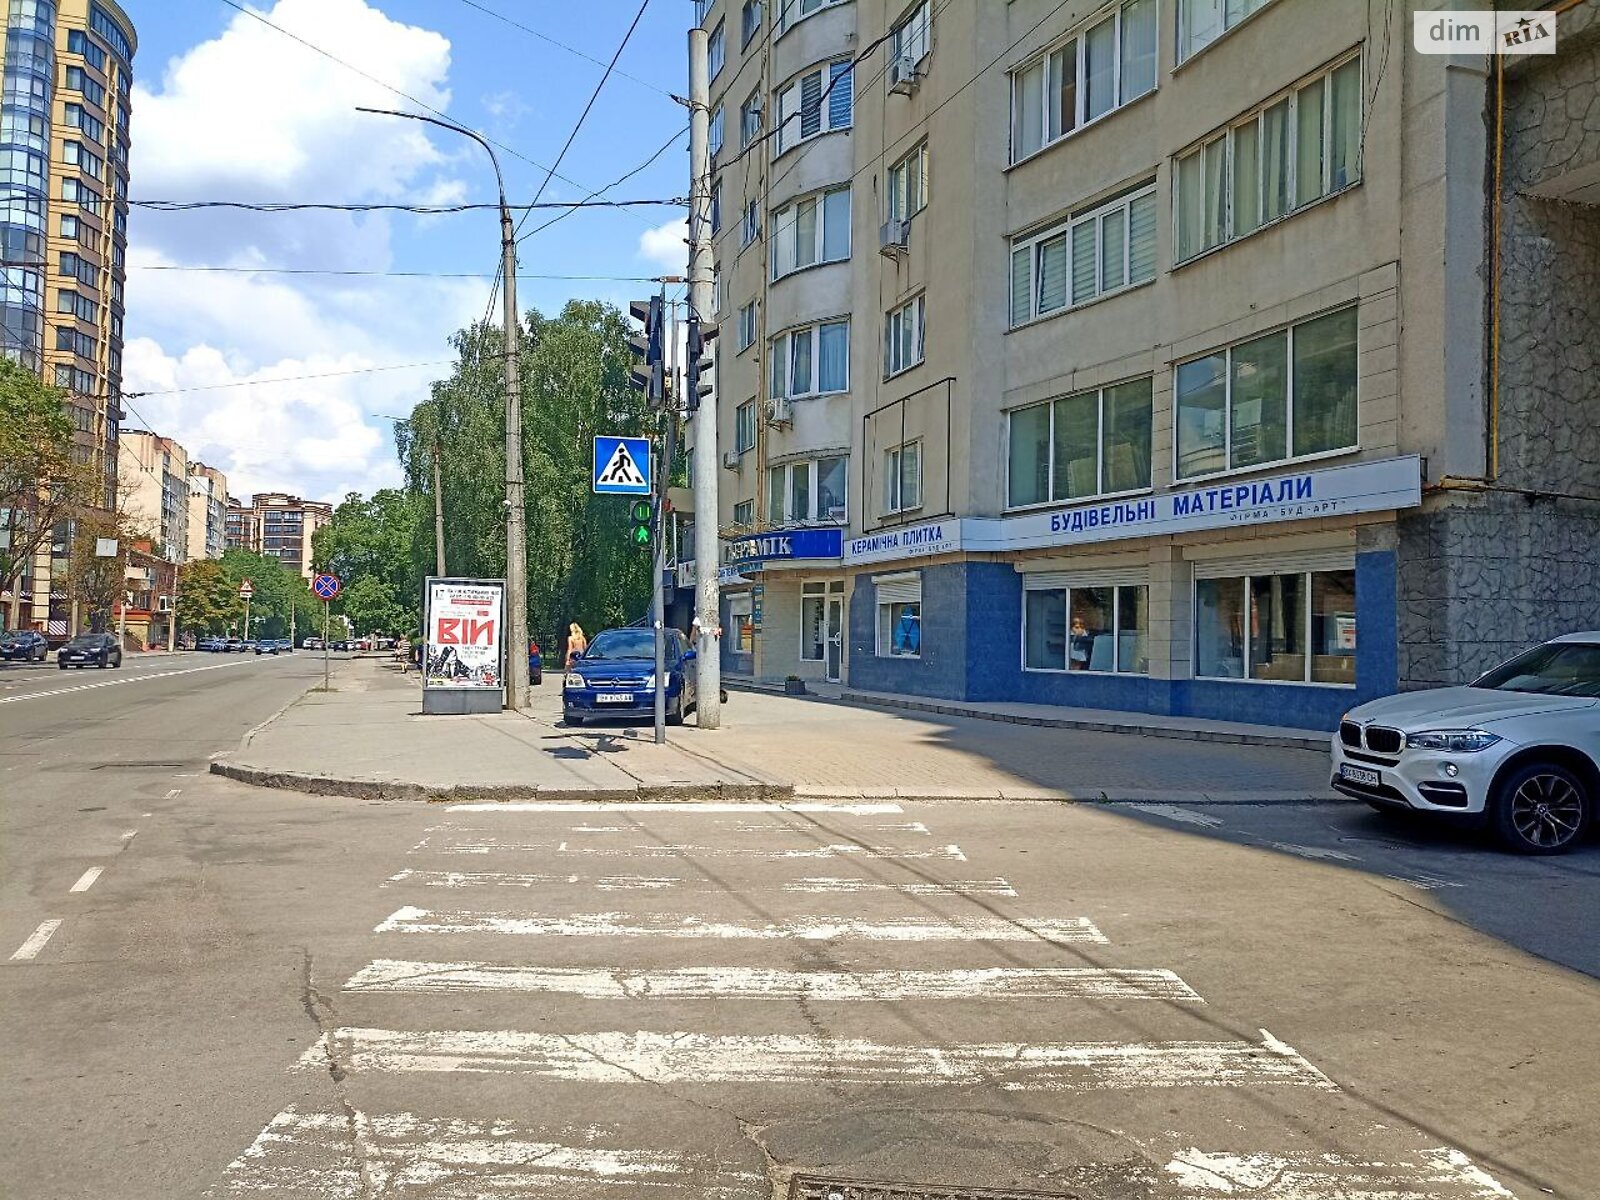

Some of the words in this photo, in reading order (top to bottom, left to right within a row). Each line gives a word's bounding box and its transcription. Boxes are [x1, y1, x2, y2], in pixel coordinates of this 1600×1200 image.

[1051, 501, 1155, 532] БУДІВЕЛЬНІ
[1173, 476, 1312, 516] МАТЕРІАЛИ
[851, 533, 898, 555] КЕРАМІЧНА
[903, 526, 942, 546] ПЛИТКА
